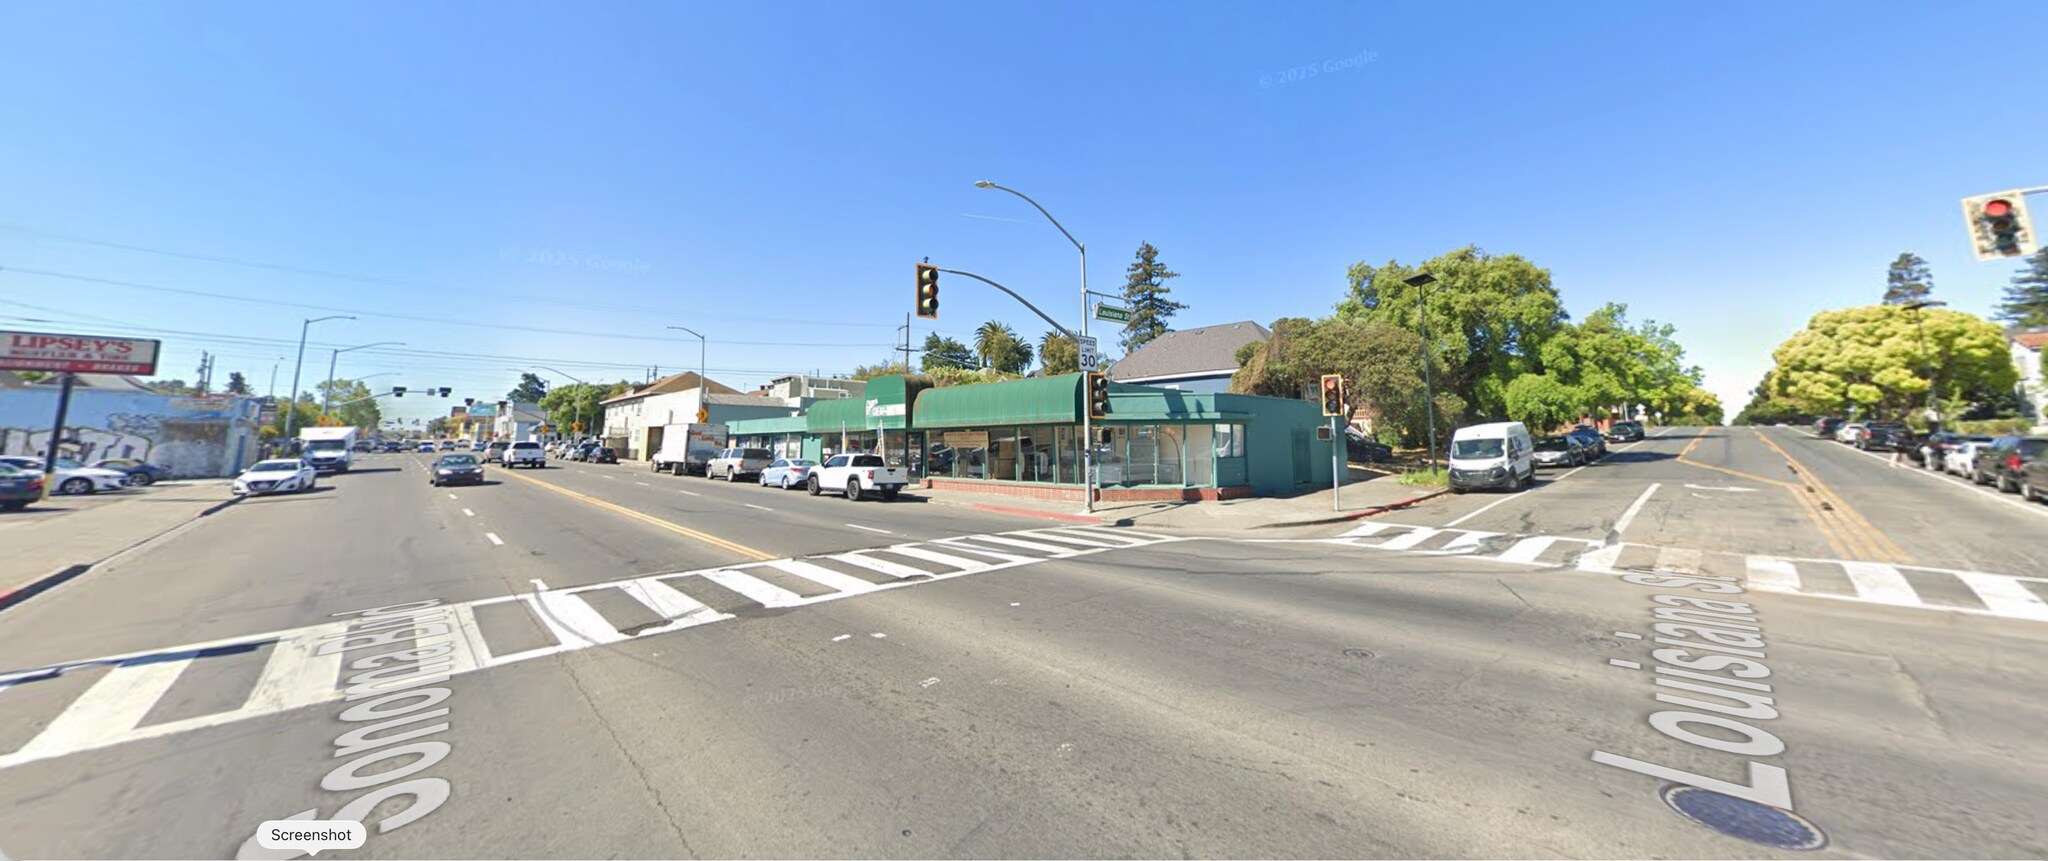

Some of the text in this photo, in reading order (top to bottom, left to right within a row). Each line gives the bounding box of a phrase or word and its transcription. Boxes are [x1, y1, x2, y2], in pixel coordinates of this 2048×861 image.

[1099, 308, 1131, 320] Louisiana St
[12, 334, 133, 353] LIPSEY'S
[1080, 338, 1096, 346] SPEED
[1081, 353, 1096, 368] 30
